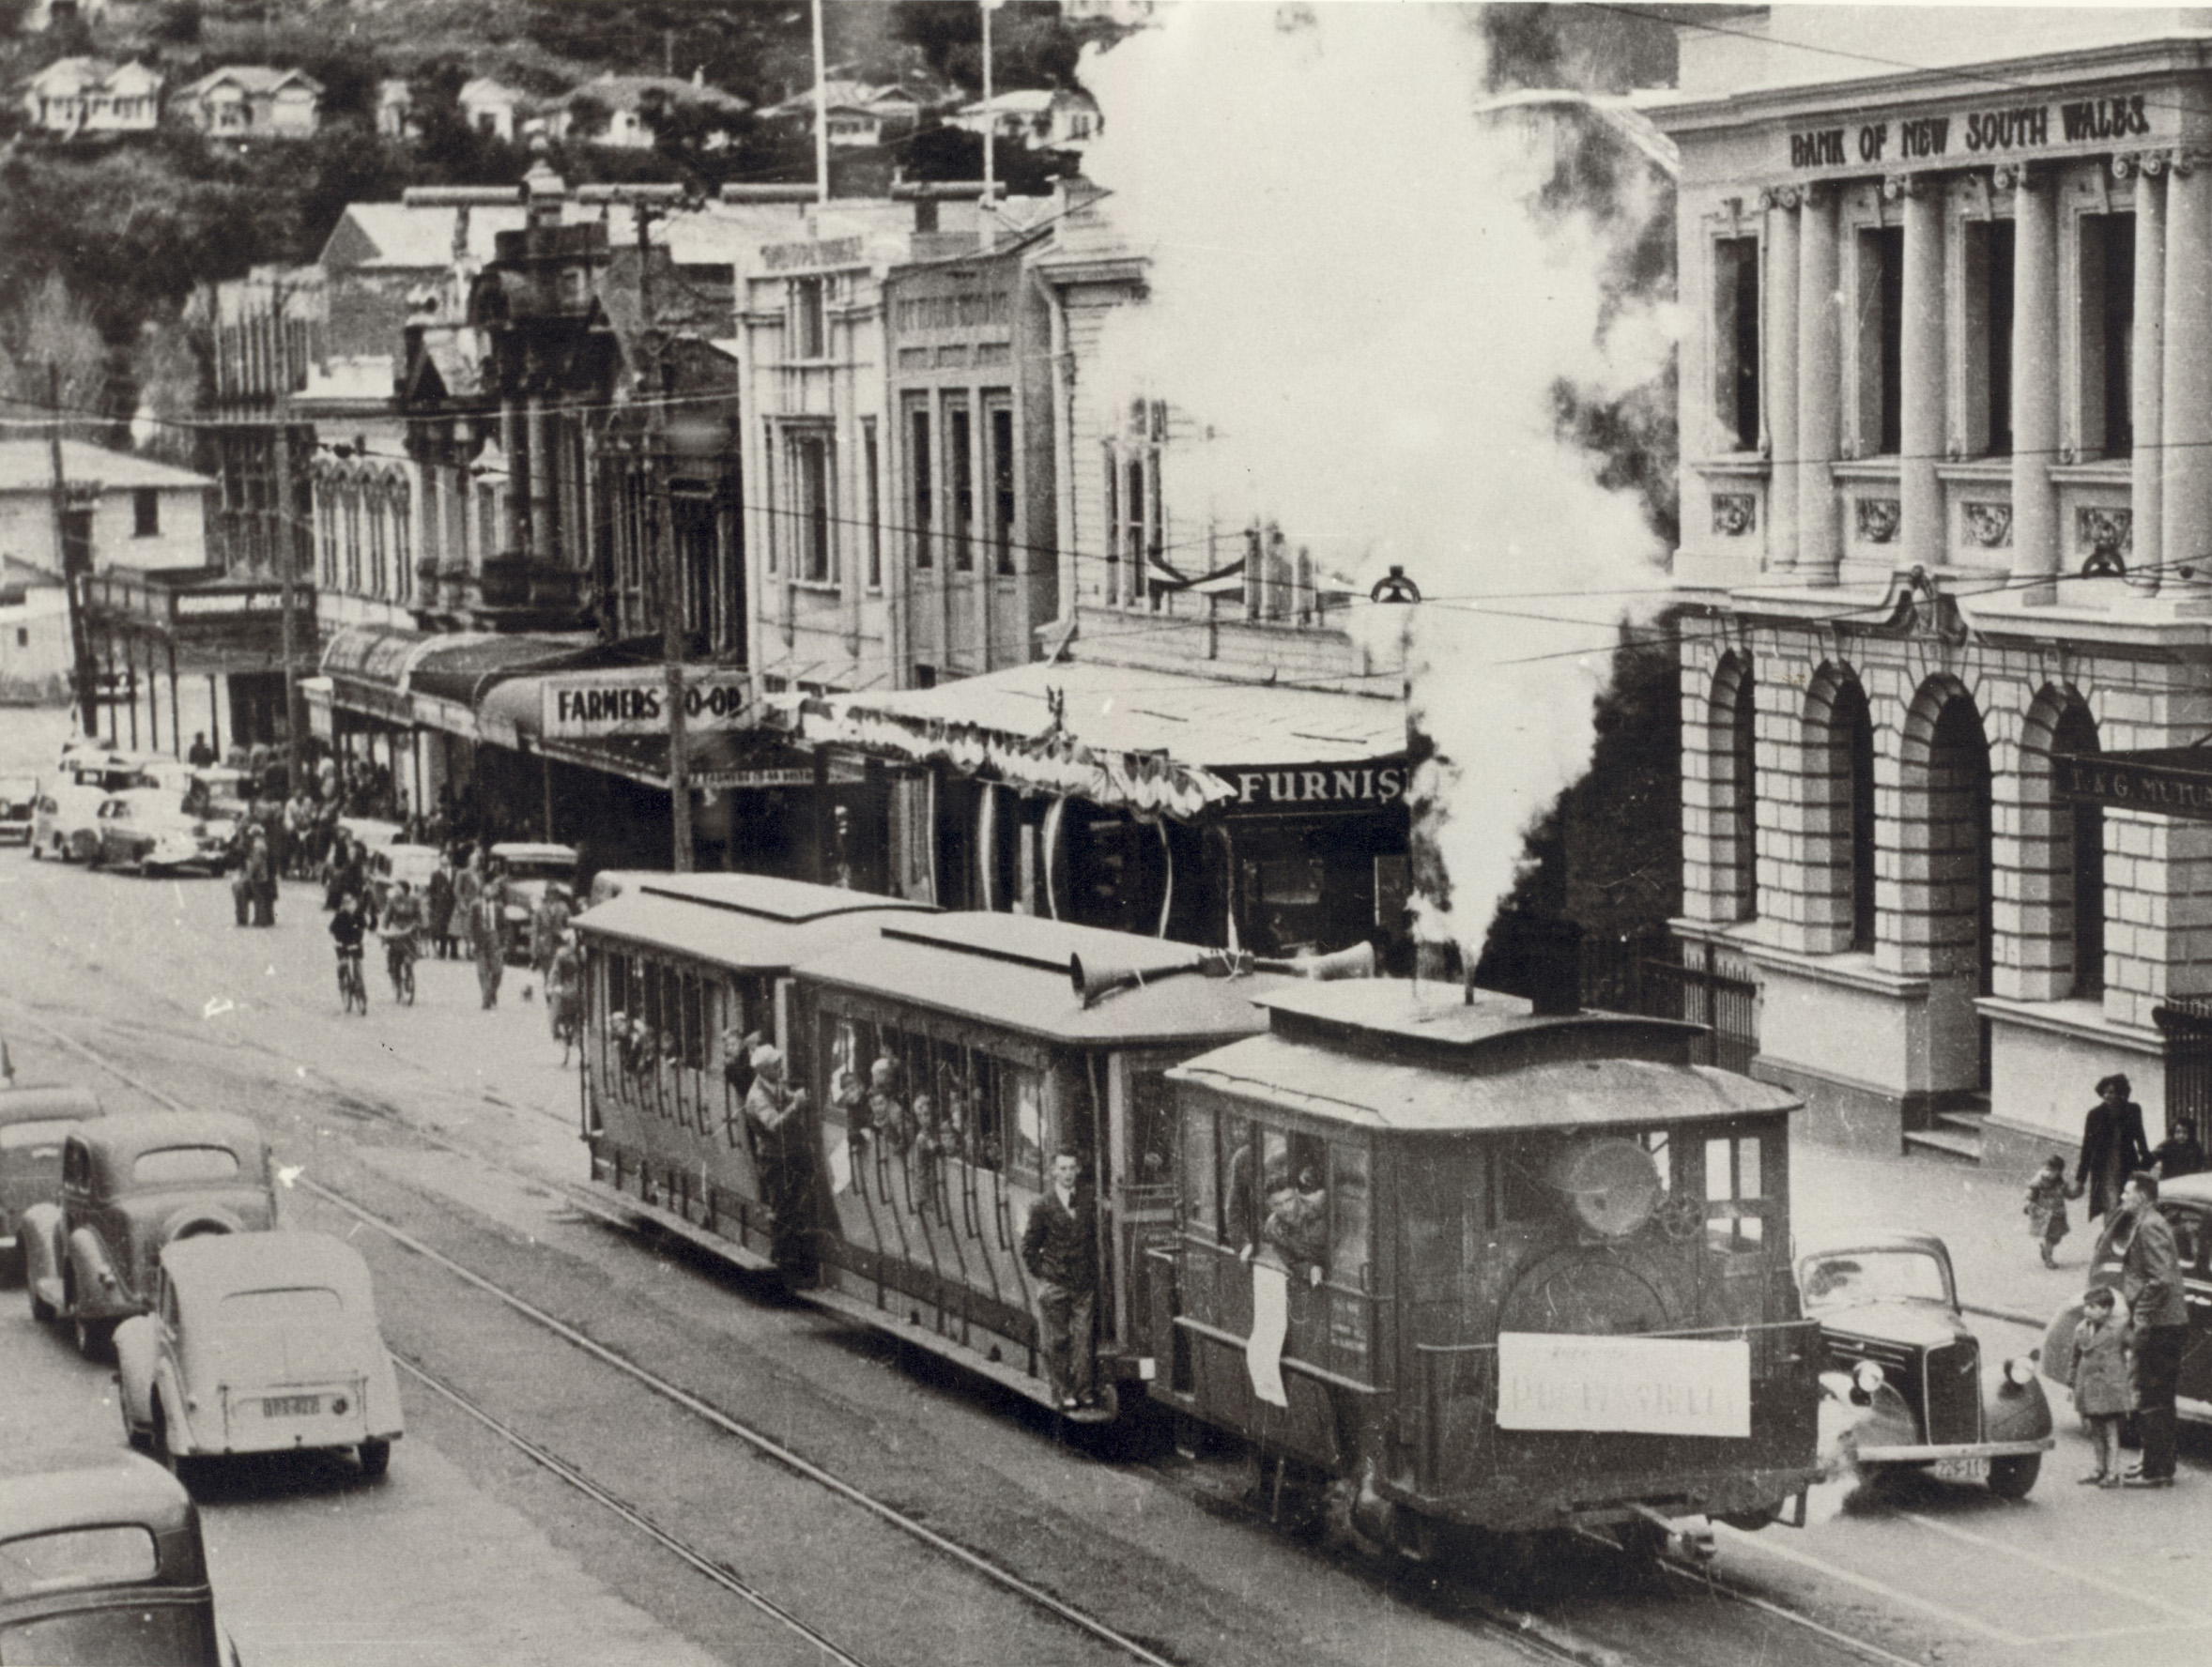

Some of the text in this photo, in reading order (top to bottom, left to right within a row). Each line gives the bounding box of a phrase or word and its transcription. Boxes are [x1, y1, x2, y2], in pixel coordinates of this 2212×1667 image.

[1790, 130, 1846, 168] BANK
[1859, 123, 1887, 162] OF
[1901, 117, 1950, 158] NEW
[1965, 105, 2049, 151] SOUTH
[558, 686, 742, 722] FARMERS O-OP
[1237, 768, 1408, 804] FURNIS
